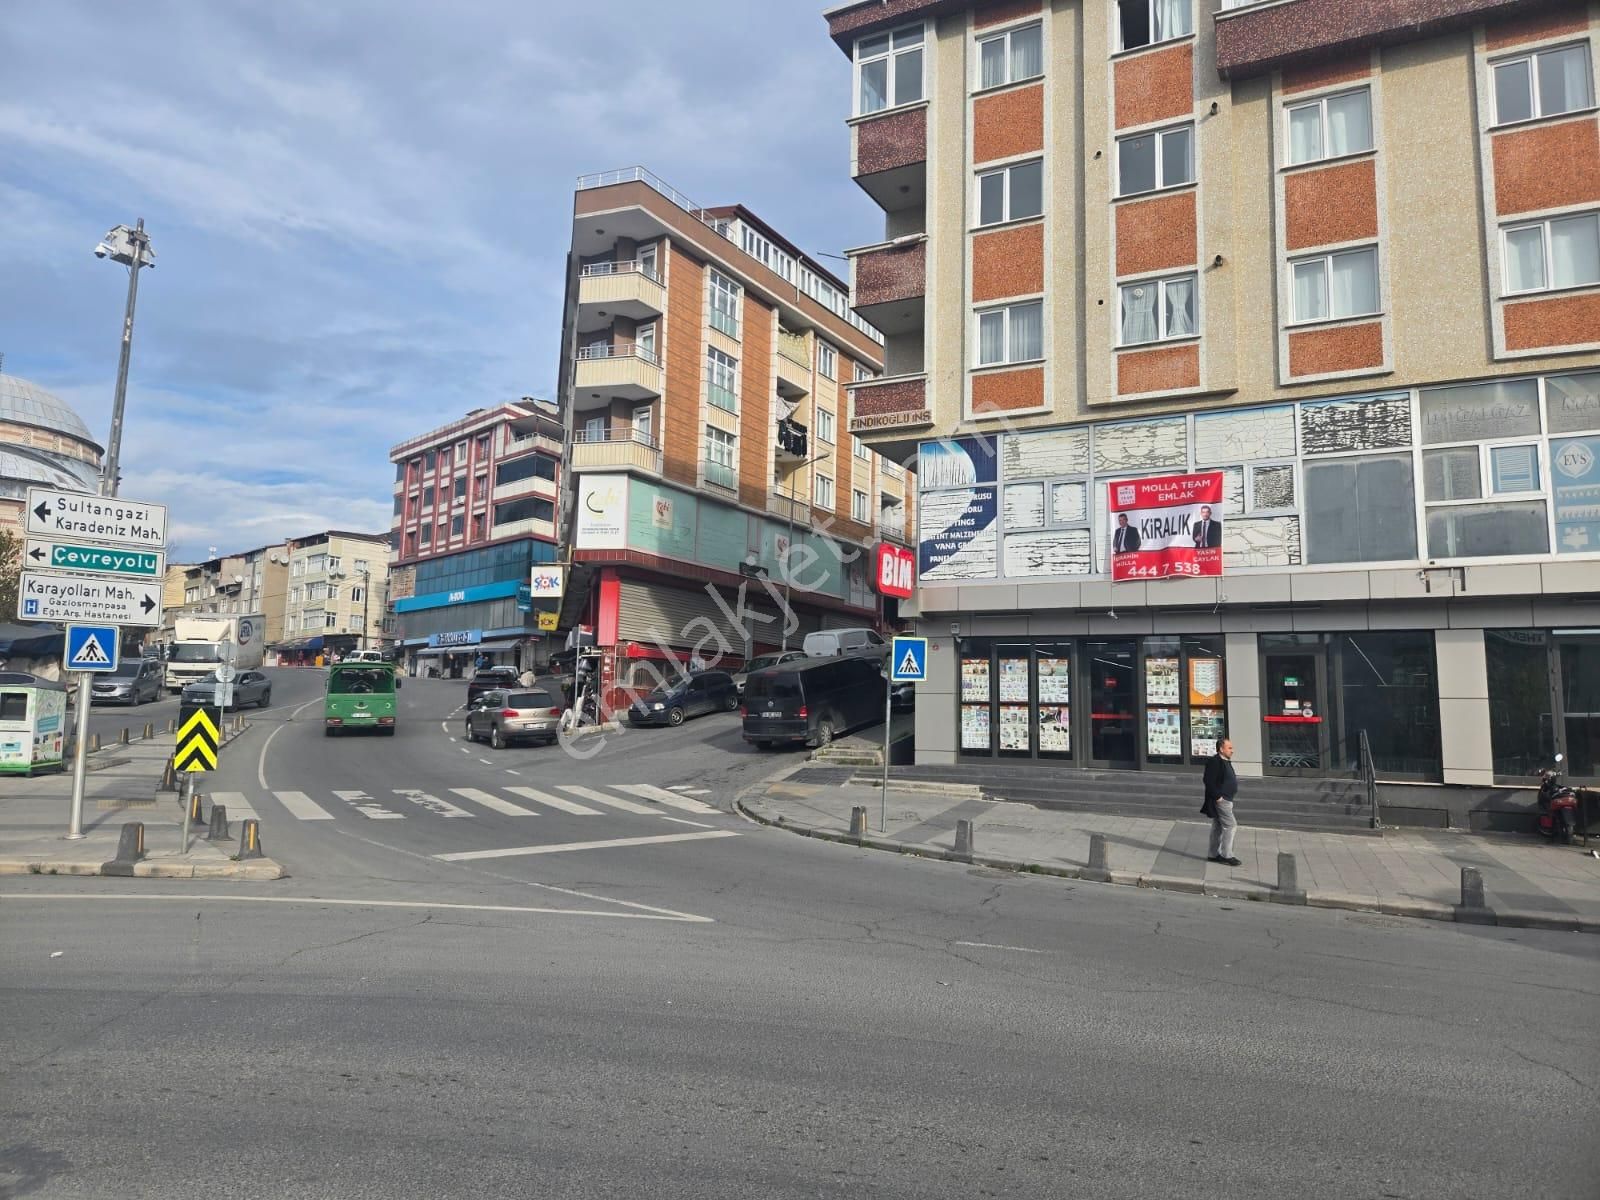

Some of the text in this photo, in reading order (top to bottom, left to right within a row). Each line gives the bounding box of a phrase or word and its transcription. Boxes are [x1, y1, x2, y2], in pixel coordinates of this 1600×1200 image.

[1563, 454, 1587, 466] EVS
[1142, 479, 1211, 493] MOLLA TEAM
[1158, 491, 1195, 502] EMLAK
[57, 497, 149, 521] Sultangazi
[55, 516, 161, 541] Karadeniz Mah.
[54, 547, 156, 569] Çevreyolu
[1127, 562, 1201, 577] 444 7 538
[27, 579, 136, 601] Karayolları Mah.
[84, 609, 132, 620] Hastanesi
